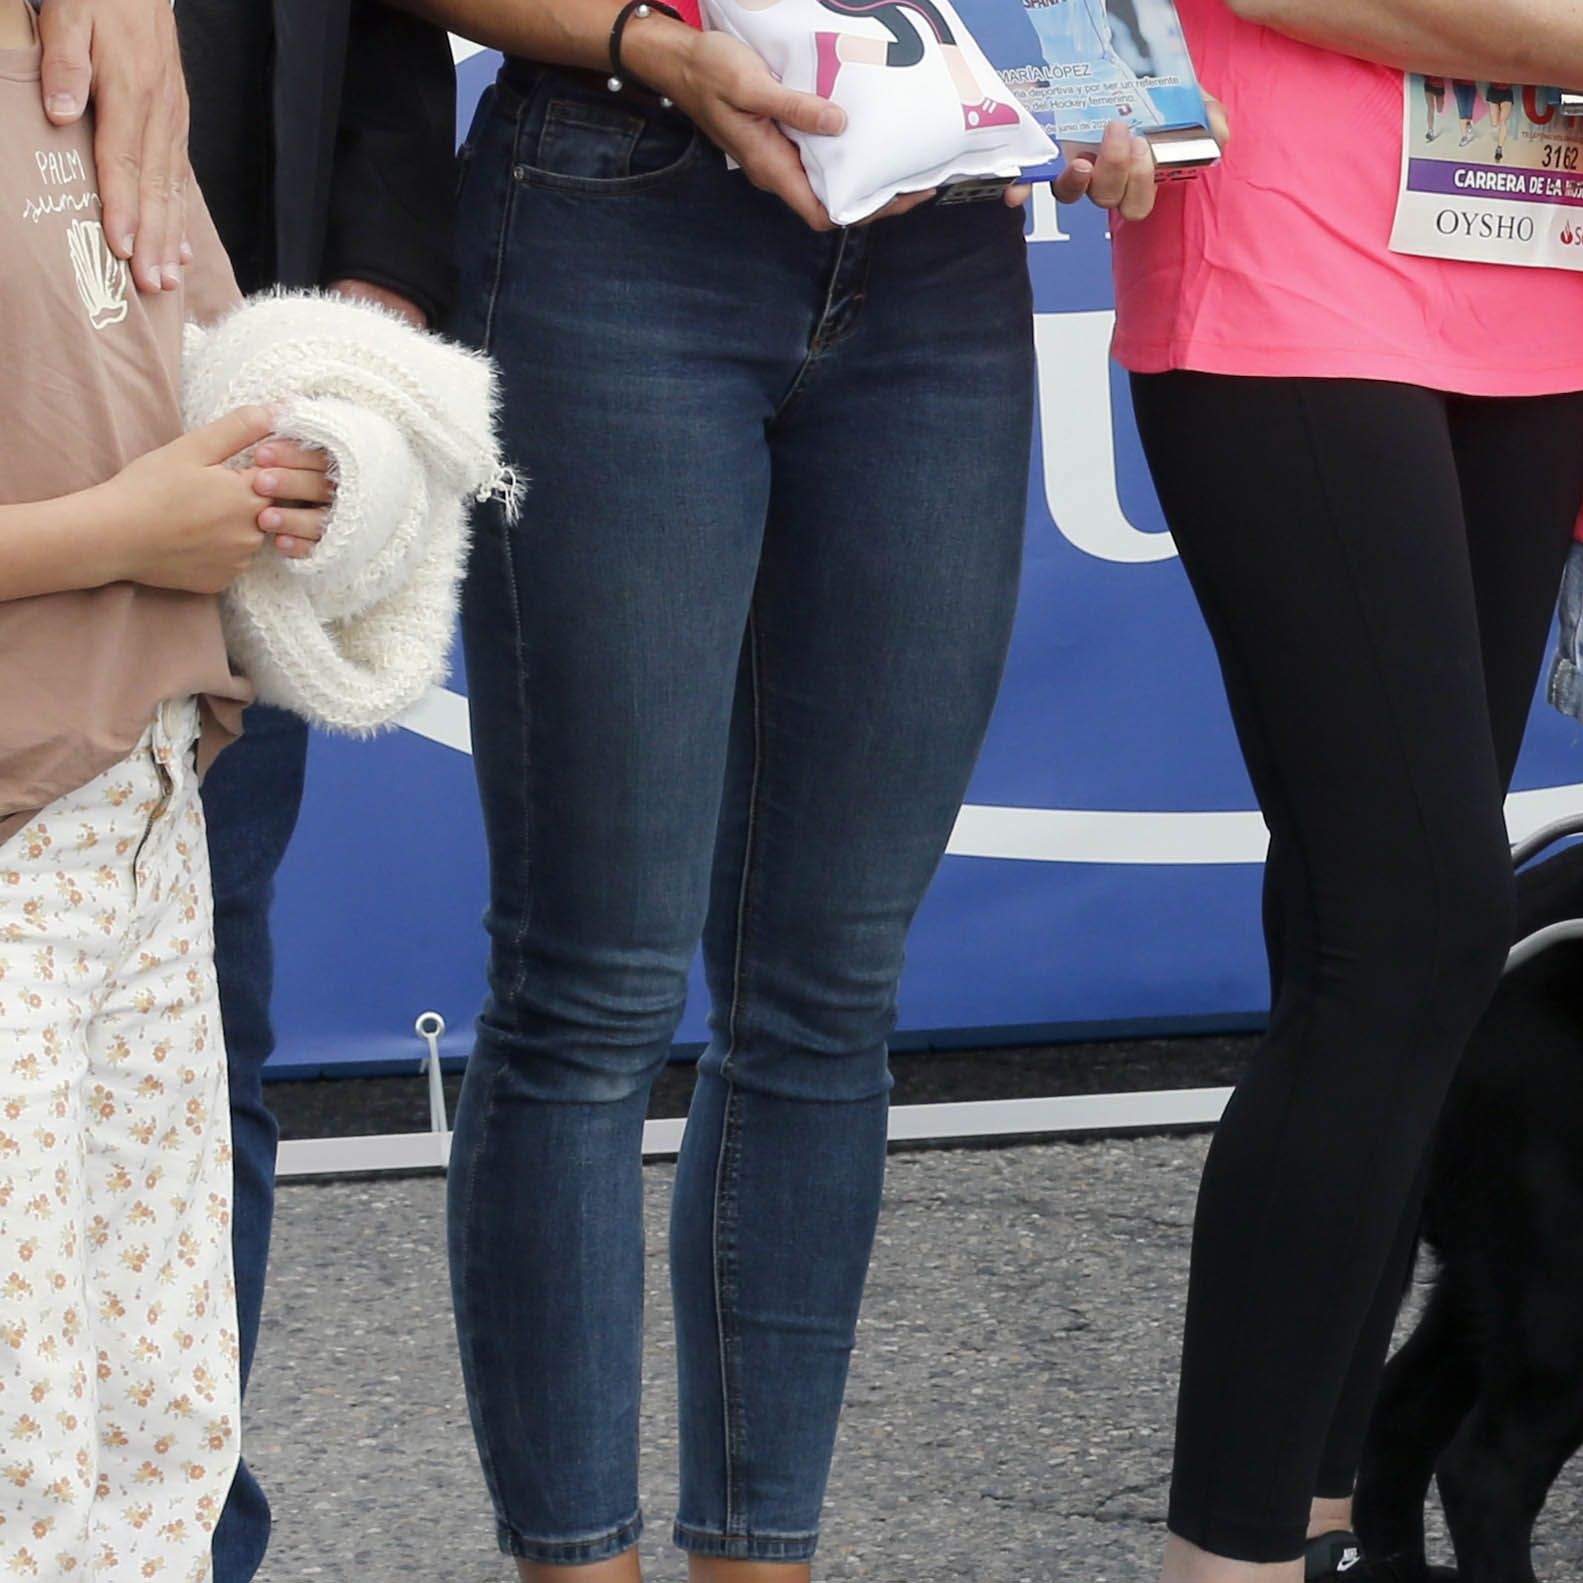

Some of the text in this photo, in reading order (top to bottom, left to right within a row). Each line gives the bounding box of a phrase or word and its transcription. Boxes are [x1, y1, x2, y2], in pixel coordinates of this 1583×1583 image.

[1046, 64, 1092, 80] LÓPEZ
[1028, 85, 1074, 99] deportiva
[1084, 83, 1100, 96] por
[1136, 76, 1180, 89] referente
[1050, 98, 1086, 111] Hockey
[34, 148, 86, 185] PALM
[1542, 144, 1579, 170] 3162
[1454, 168, 1525, 194] CARRERA
[1529, 176, 1545, 194] DE
[1436, 209, 1535, 242] OYSHO
